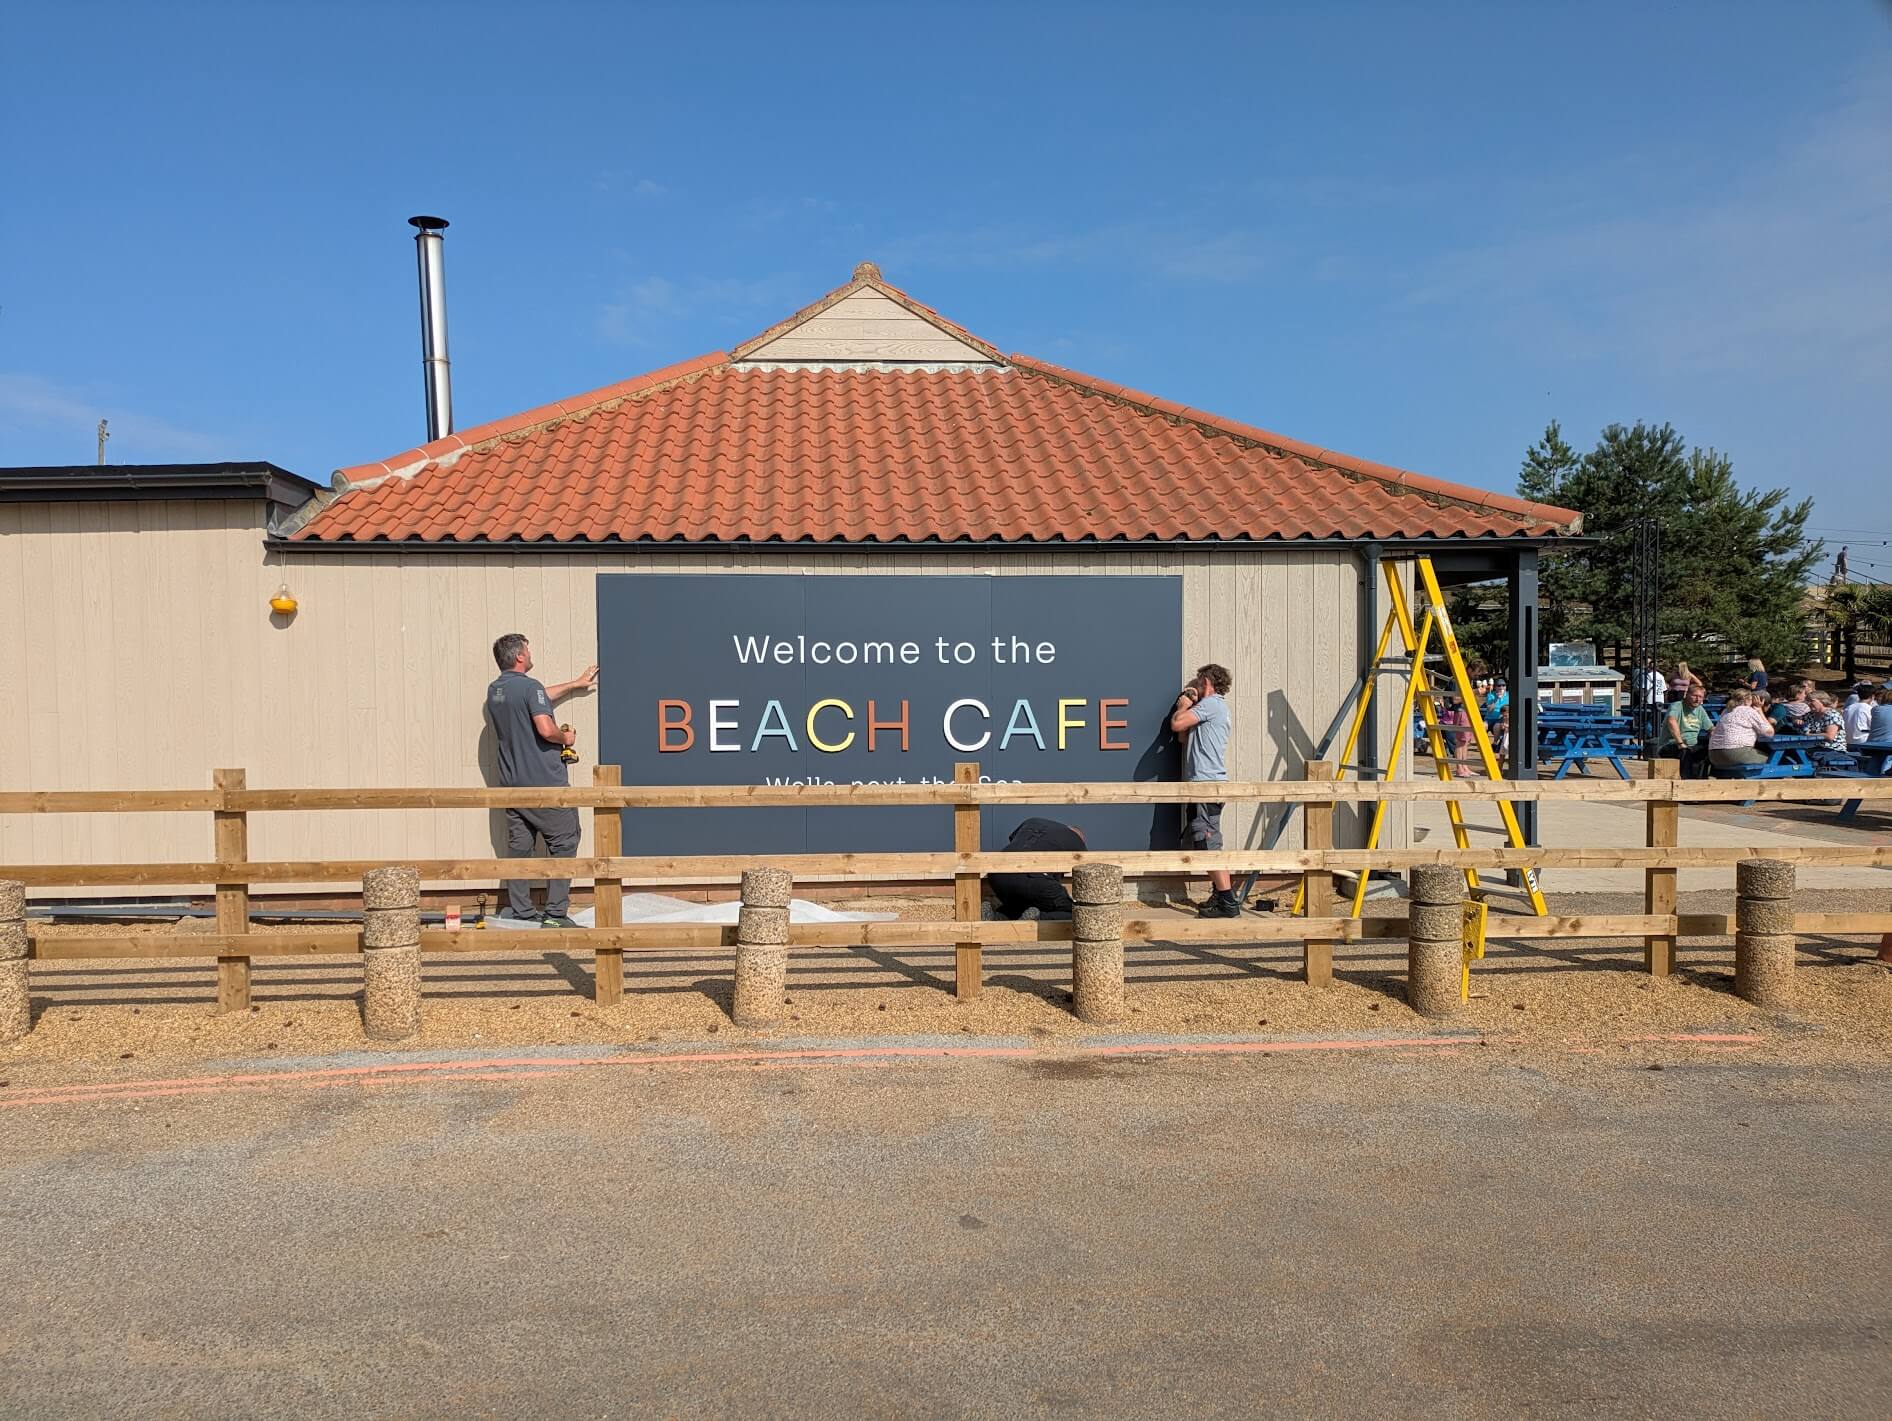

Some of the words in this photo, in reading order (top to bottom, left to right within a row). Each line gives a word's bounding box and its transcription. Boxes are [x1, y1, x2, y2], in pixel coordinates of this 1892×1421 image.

[733, 634, 921, 665] Welcome
[935, 636, 977, 665] to
[991, 635, 1057, 665] the
[657, 698, 910, 753] BEACH
[942, 698, 1131, 753] CAFE
